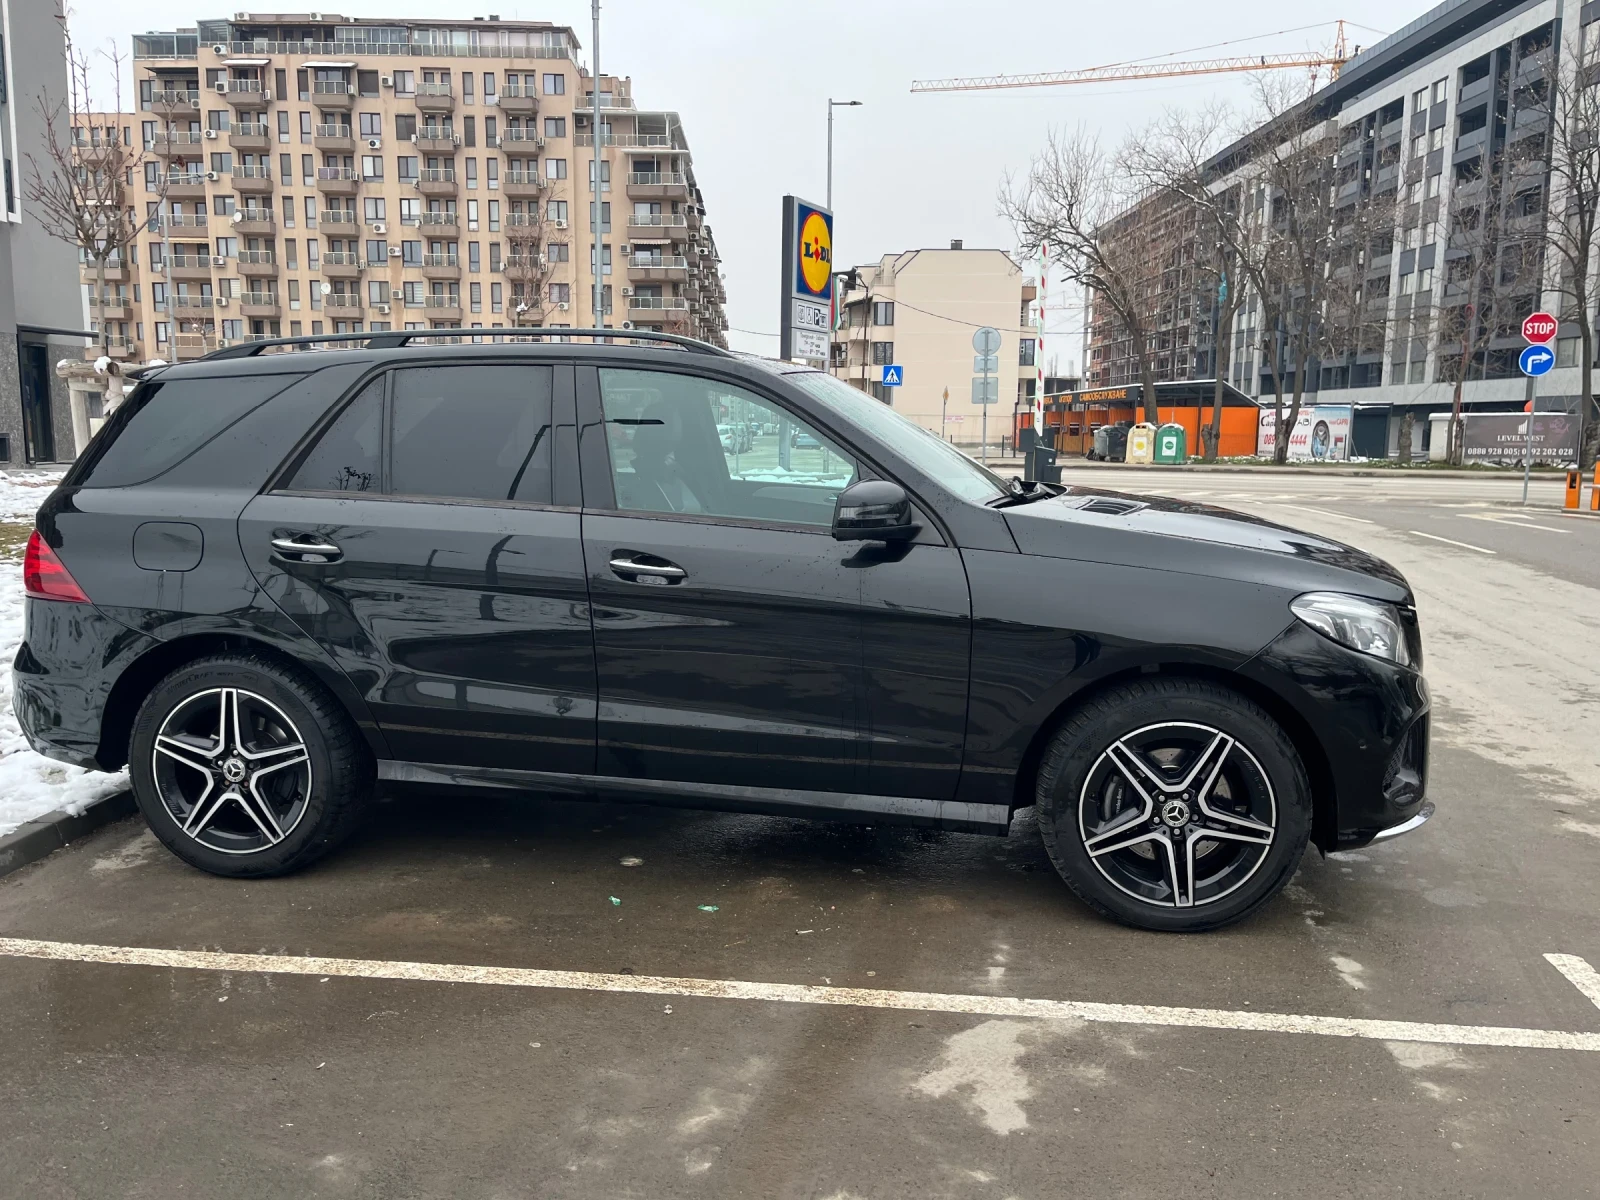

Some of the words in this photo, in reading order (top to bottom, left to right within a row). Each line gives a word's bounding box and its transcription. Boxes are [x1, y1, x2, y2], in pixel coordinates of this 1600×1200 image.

[1525, 322, 1554, 335] STOP
[1467, 447, 1486, 455] 0888
[1488, 447, 1502, 455] 928
[1521, 447, 1540, 456] 092
[1542, 447, 1557, 456] 202
[1558, 447, 1574, 456] 028
